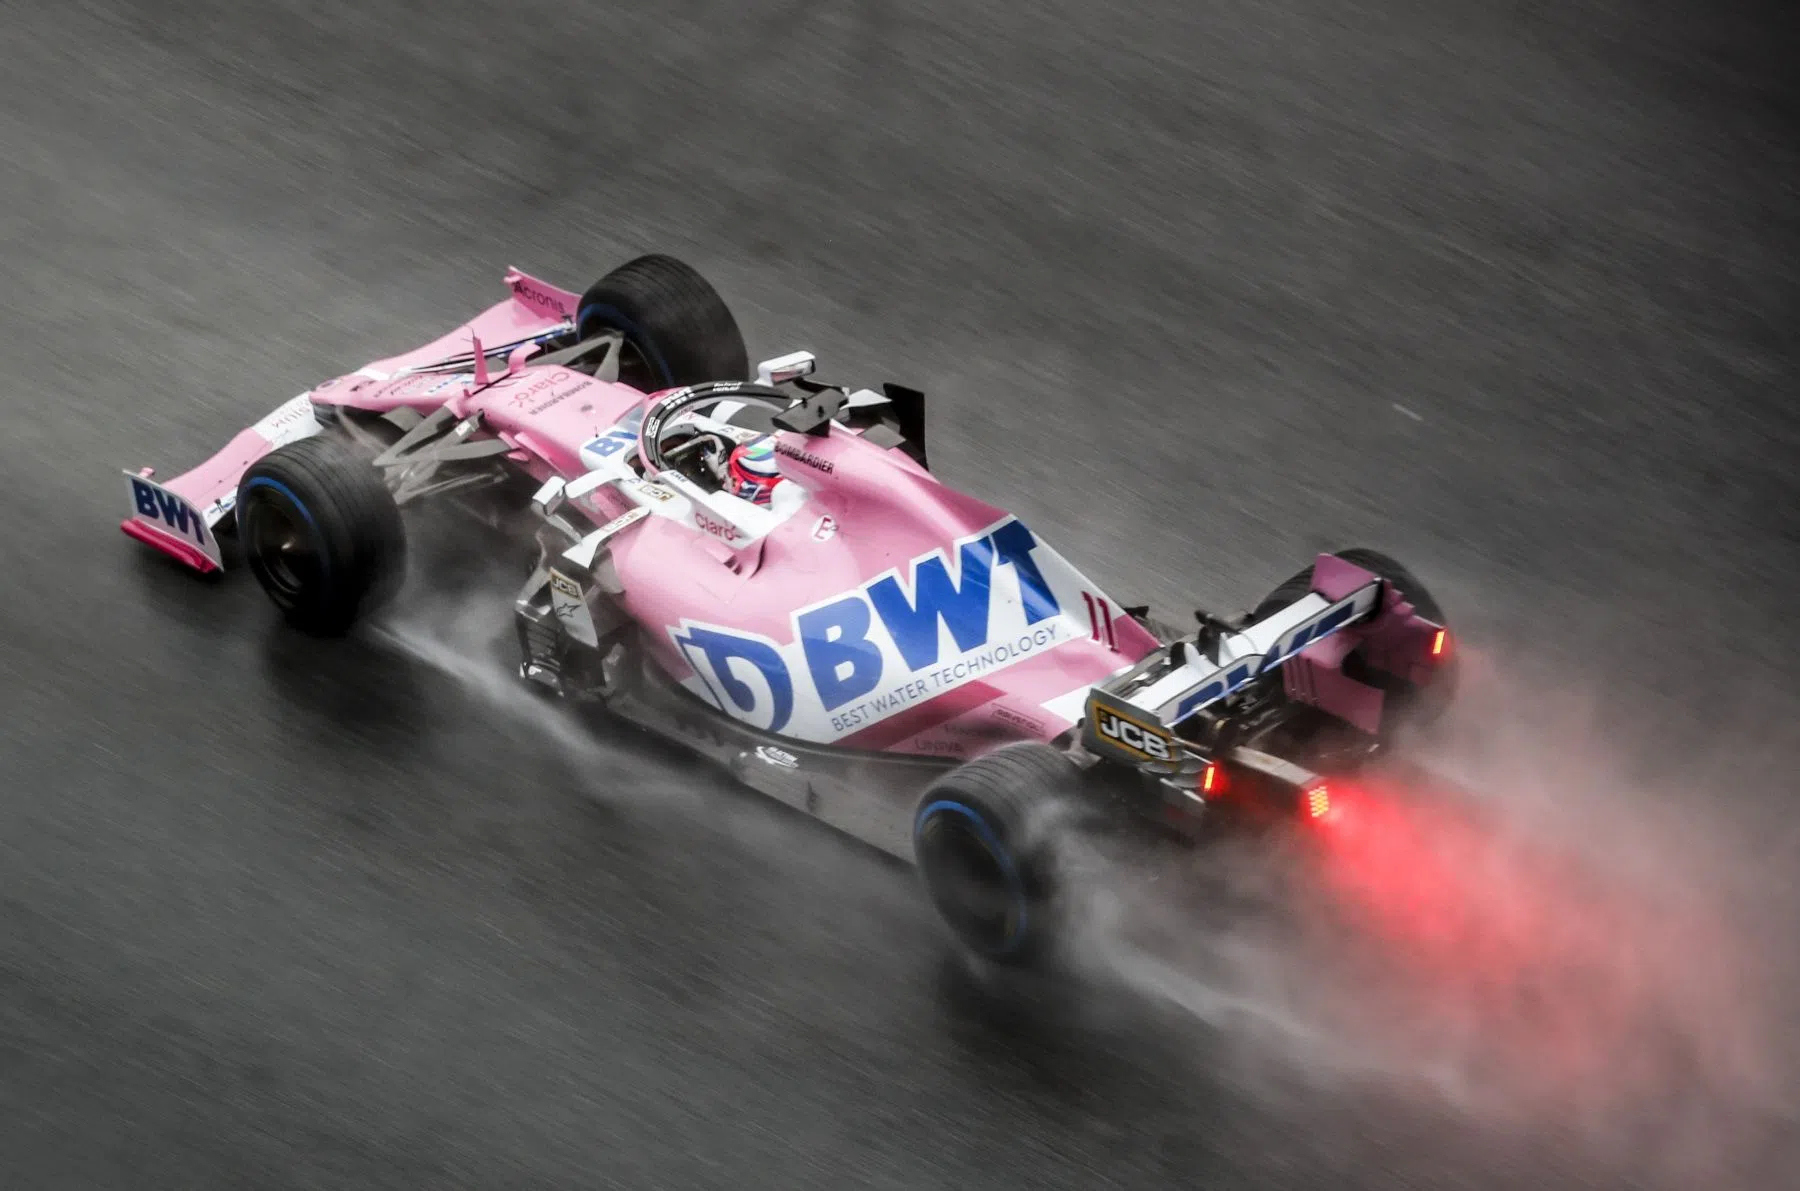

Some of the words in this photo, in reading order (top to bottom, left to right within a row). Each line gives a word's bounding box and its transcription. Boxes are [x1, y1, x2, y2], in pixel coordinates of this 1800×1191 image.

[512, 281, 566, 314] Acronis
[774, 440, 835, 475] BOMBARDIER
[131, 478, 206, 546] BWT
[694, 512, 742, 541] Claro
[797, 519, 1061, 713] BWT
[1080, 590, 1120, 652] 11
[830, 705, 869, 733] BEST
[869, 678, 929, 713] WATER
[930, 623, 1059, 687] TECHNOLOGY
[1100, 715, 1169, 760] JCB
